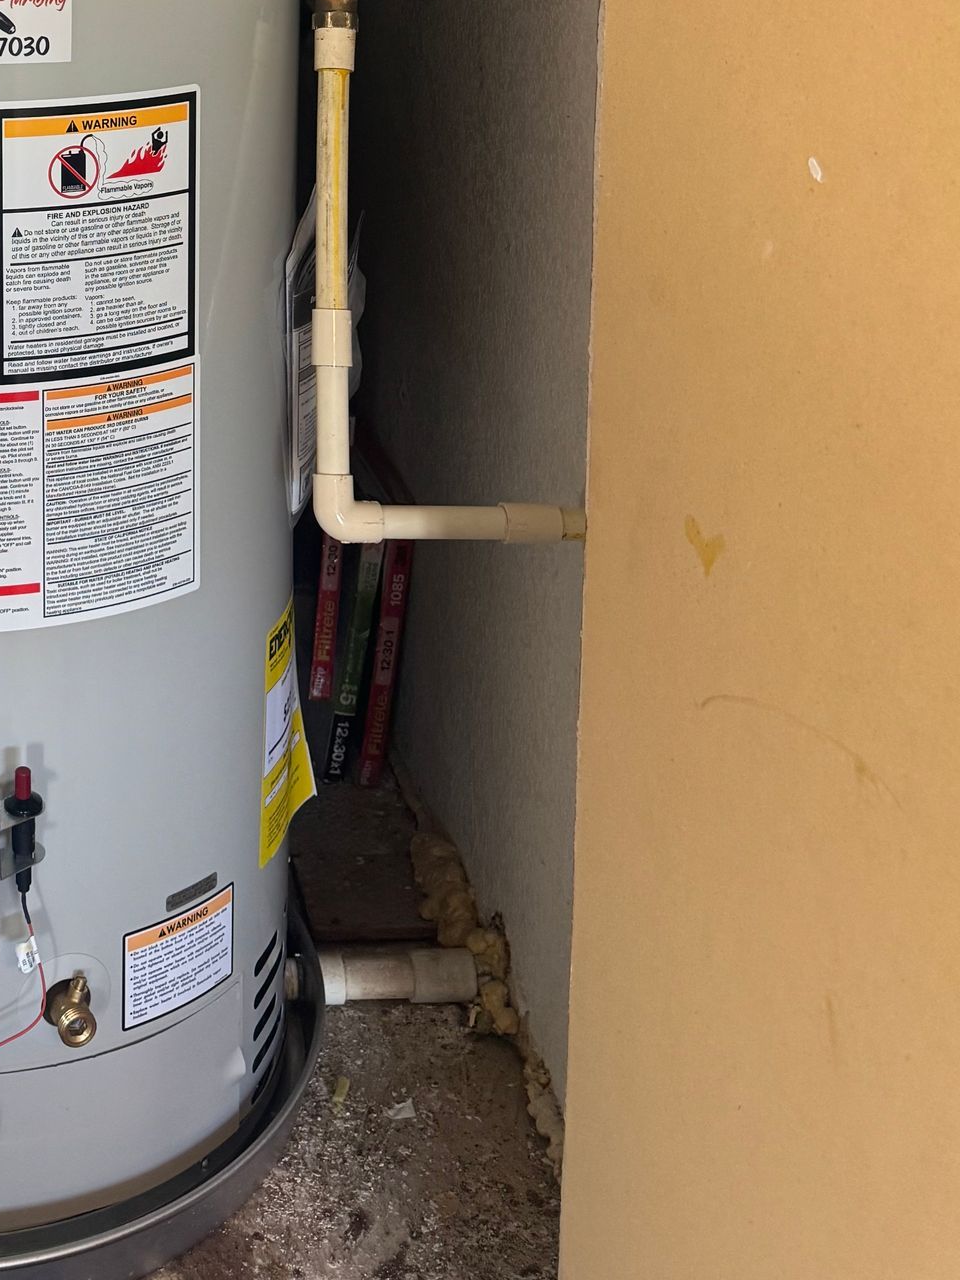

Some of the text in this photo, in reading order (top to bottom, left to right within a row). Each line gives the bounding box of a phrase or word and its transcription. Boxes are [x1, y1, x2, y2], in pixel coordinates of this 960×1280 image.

[82, 116, 137, 130] WARNING
[101, 182, 152, 194] Flammable Vapors
[83, 207, 121, 217] EXPLOSION
[123, 203, 149, 212] HAZARD
[65, 217, 80, 225] result
[88, 215, 108, 223] serious
[109, 213, 124, 222] injury
[132, 210, 146, 218] death
[80, 223, 103, 233] gasoline
[127, 216, 152, 226] flammable
[154, 214, 169, 223] vapors
[171, 211, 179, 219] and
[67, 247, 94, 257] appliance
[107, 242, 122, 251] result
[148, 237, 161, 246] injury
[113, 379, 143, 390] WARNING
[109, 390, 124, 398] YOUR
[126, 386, 146, 396] SAFETY
[113, 409, 143, 420] WARNING
[84, 424, 105, 432] PRODUCE
[390, 574, 404, 606] 1085
[318, 599, 336, 661] Filtrete
[165, 907, 209, 934] WARNING
